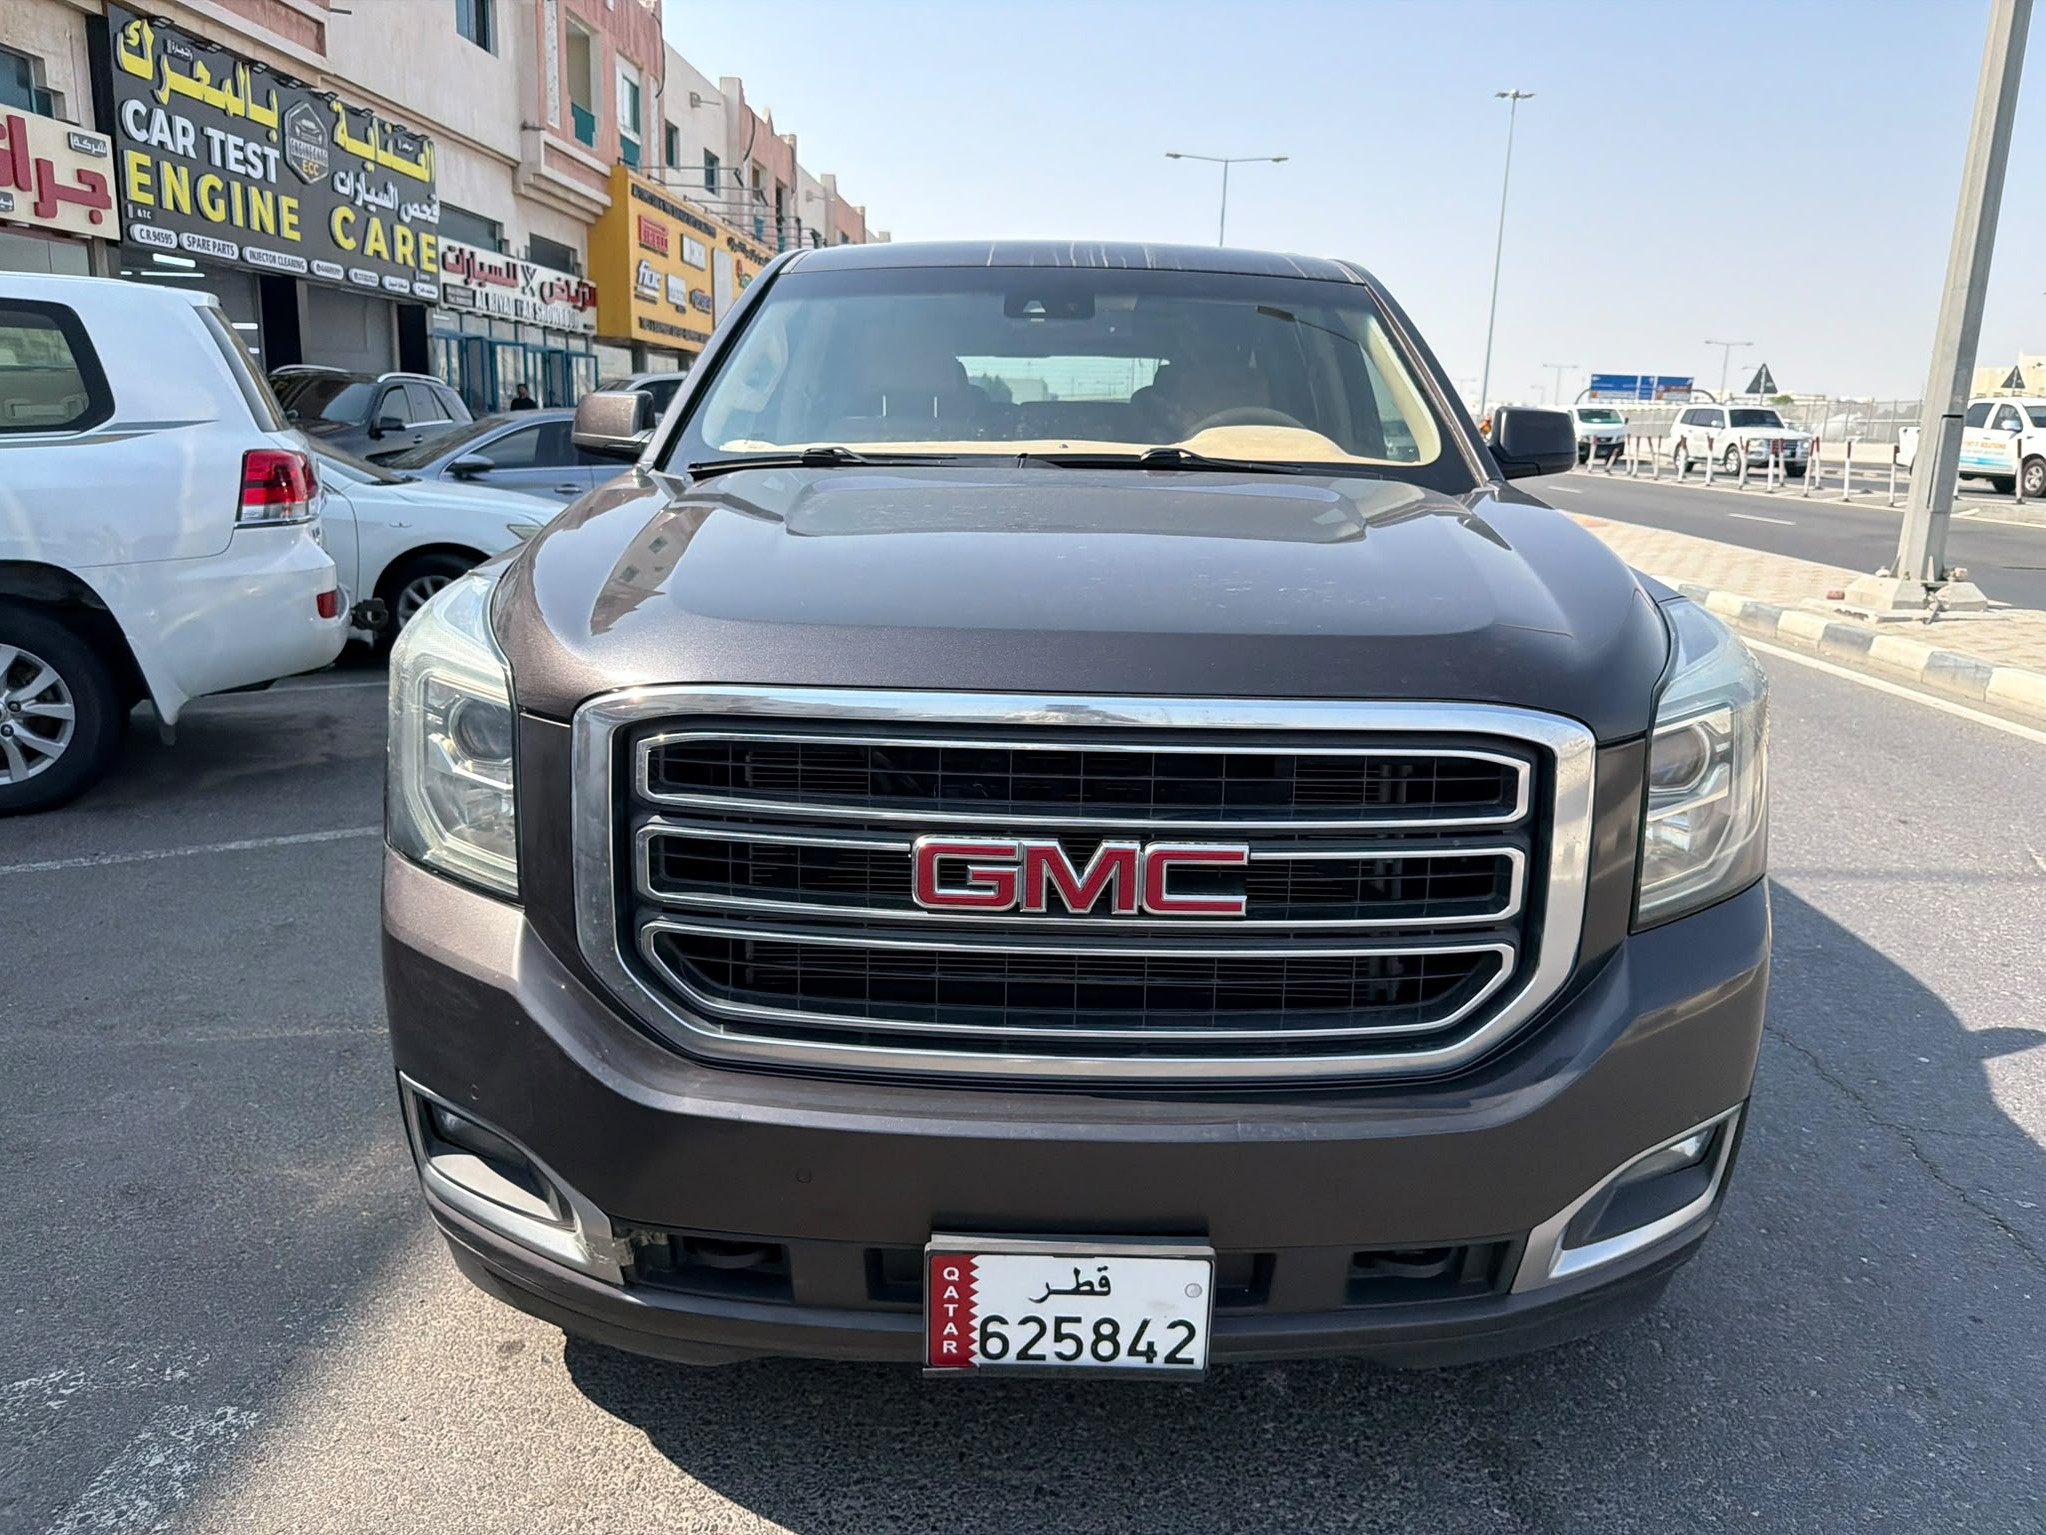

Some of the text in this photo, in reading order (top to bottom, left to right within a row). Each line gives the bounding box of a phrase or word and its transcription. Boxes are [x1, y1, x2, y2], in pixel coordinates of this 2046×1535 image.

[116, 18, 435, 183] العناية بالمحرك
[73, 135, 107, 153] شركة
[121, 99, 280, 183] CAR TEST
[303, 159, 320, 177] ECC
[123, 148, 438, 273] ENGINE CARE
[333, 170, 440, 224] فحص السيارات
[186, 235, 235, 257] SPARE PARTS
[475, 289, 489, 311] AL
[911, 834, 1249, 917] GMC
[942, 1267, 959, 1354] QATAR
[1028, 1265, 1111, 1303] قطر
[979, 1314, 1197, 1366] 625842
